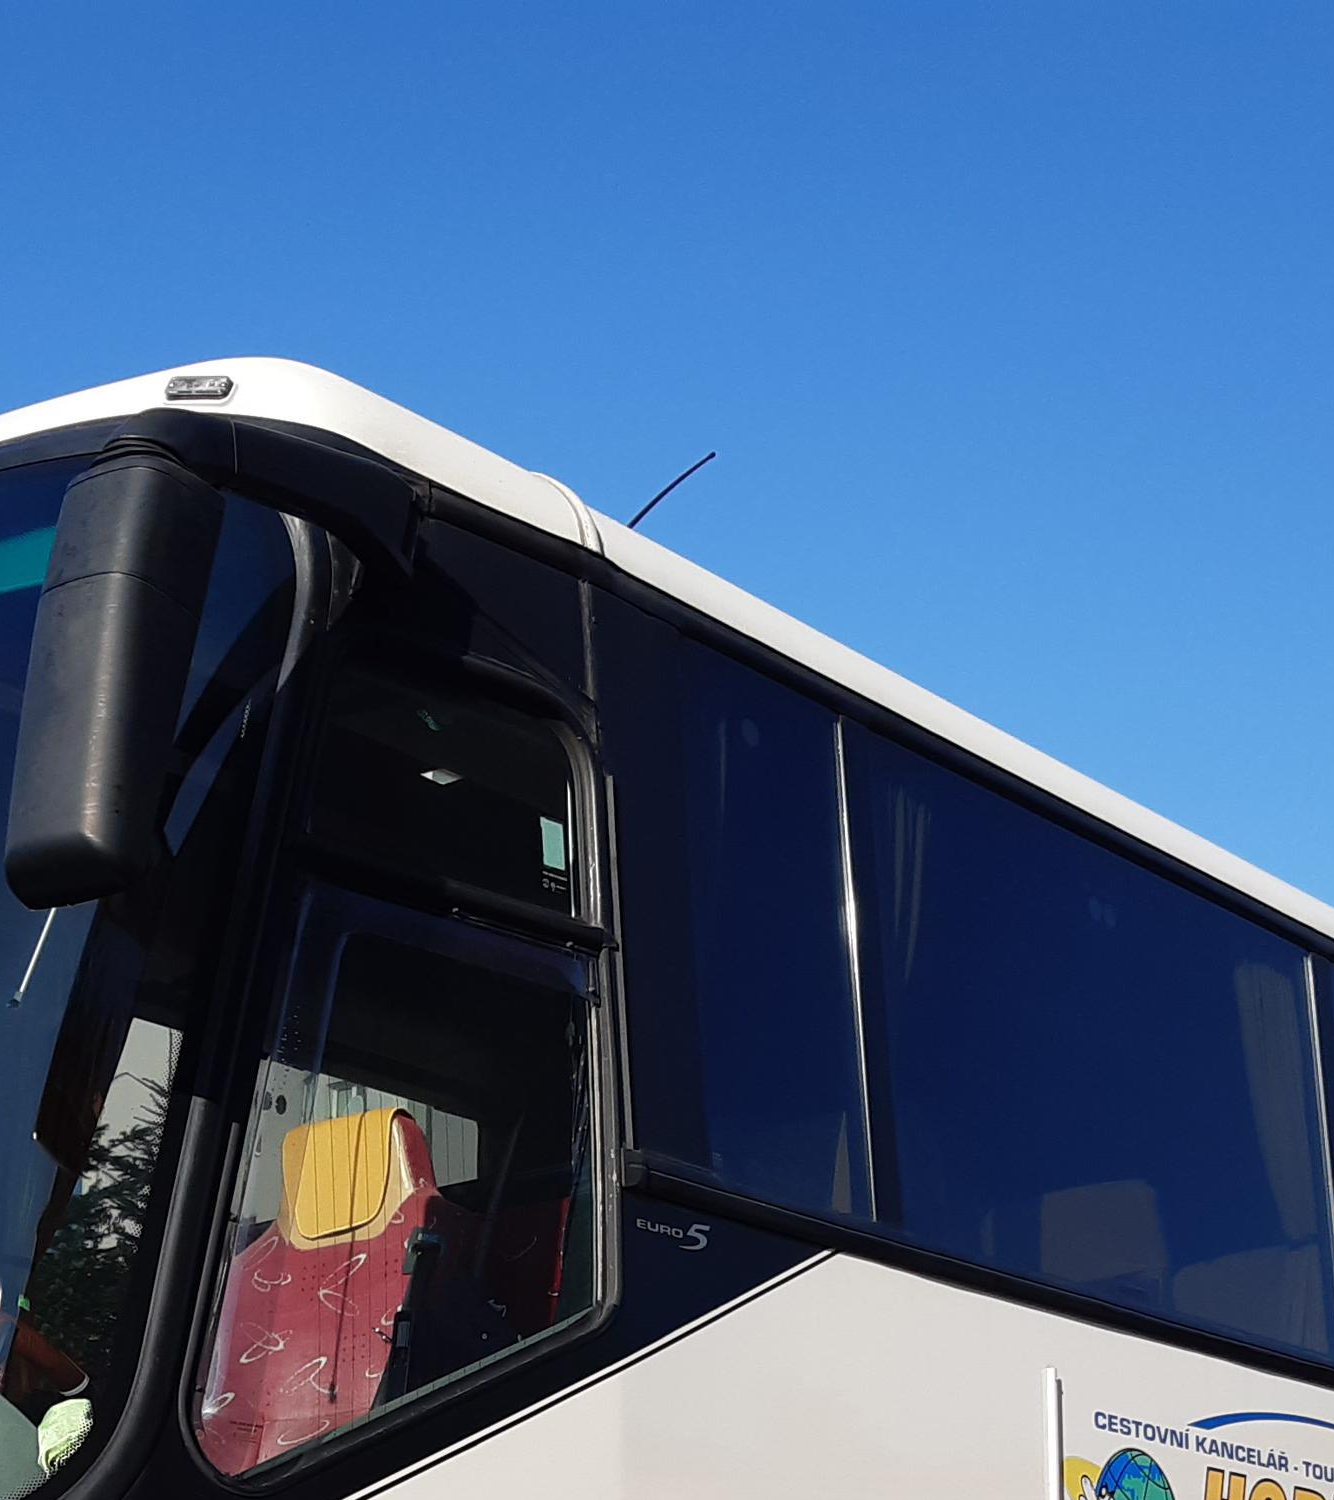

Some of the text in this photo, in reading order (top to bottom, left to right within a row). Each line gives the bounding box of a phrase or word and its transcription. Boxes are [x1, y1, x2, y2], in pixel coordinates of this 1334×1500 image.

[636, 1218, 711, 1251] EURO 5
[1094, 1411, 1190, 1450] CESTOVNÍ
[1195, 1435, 1289, 1473] KANCELÁŘ
